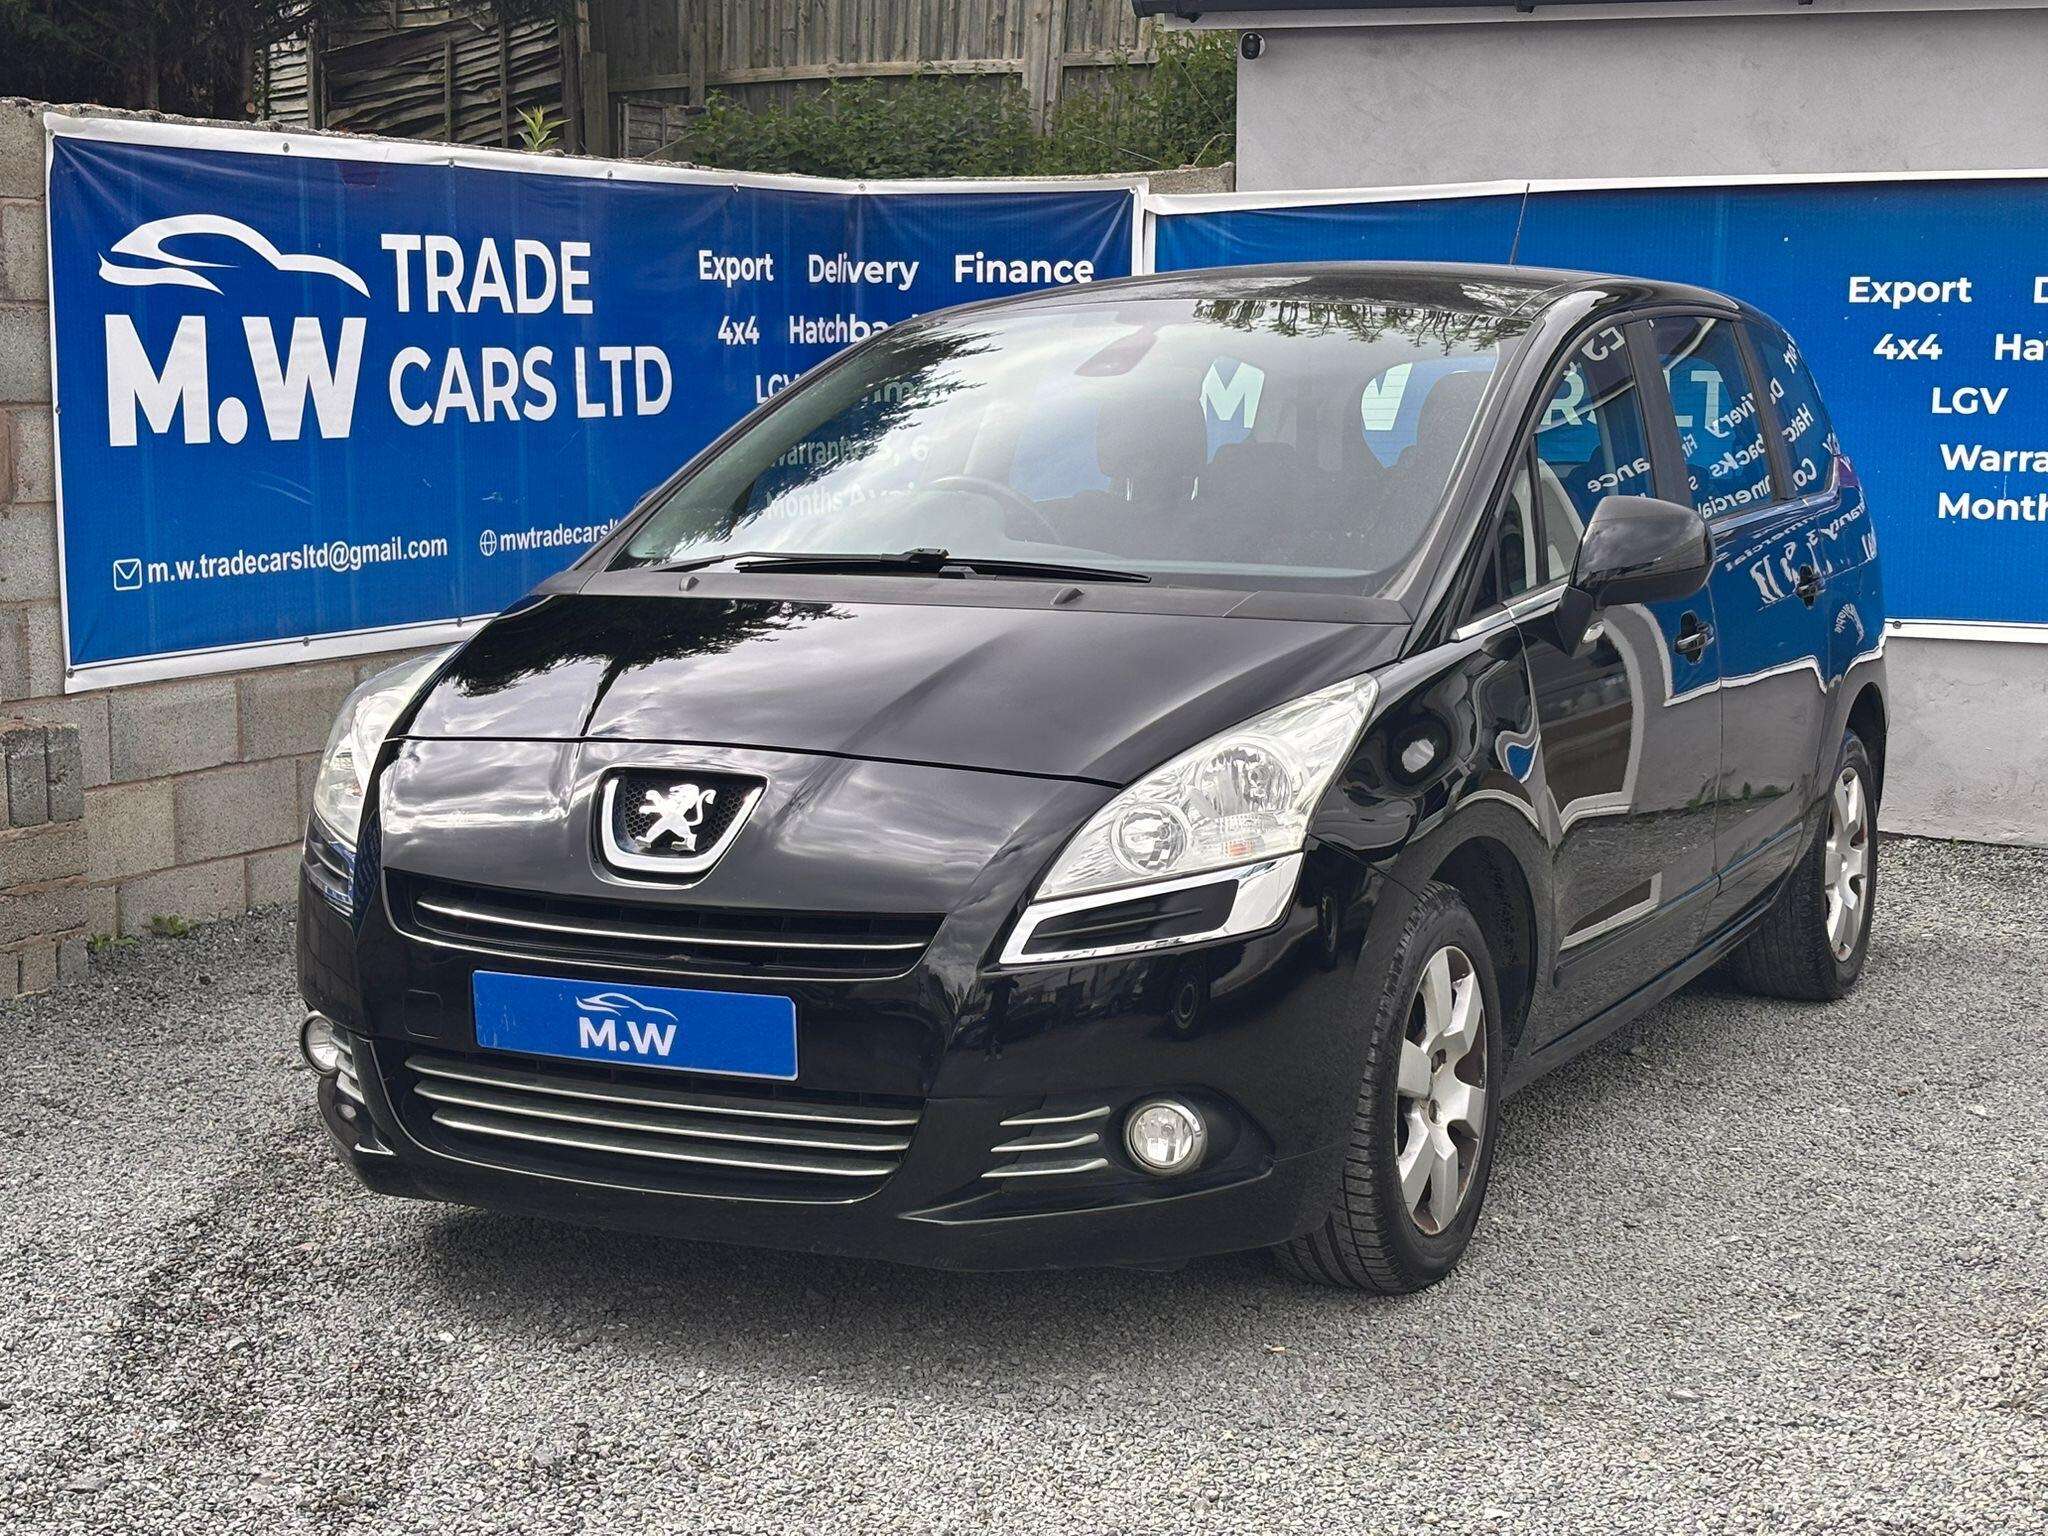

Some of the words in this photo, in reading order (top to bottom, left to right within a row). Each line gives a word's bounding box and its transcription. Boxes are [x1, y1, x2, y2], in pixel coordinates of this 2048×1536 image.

[381, 233, 594, 315] TRADE
[698, 250, 774, 288] Export
[808, 252, 919, 291] Delivery
[954, 251, 1095, 284] Finance
[1848, 276, 1973, 310] Export
[718, 315, 759, 345] 4x4
[1873, 333, 1943, 361] 4x4
[105, 313, 367, 447] M.W
[388, 345, 558, 426] CARS
[573, 345, 673, 419] LTD
[1931, 386, 2009, 415] LGV
[148, 536, 448, 584] m.w.tradecarsltd@gmail.com
[579, 1016, 676, 1056] M.W
